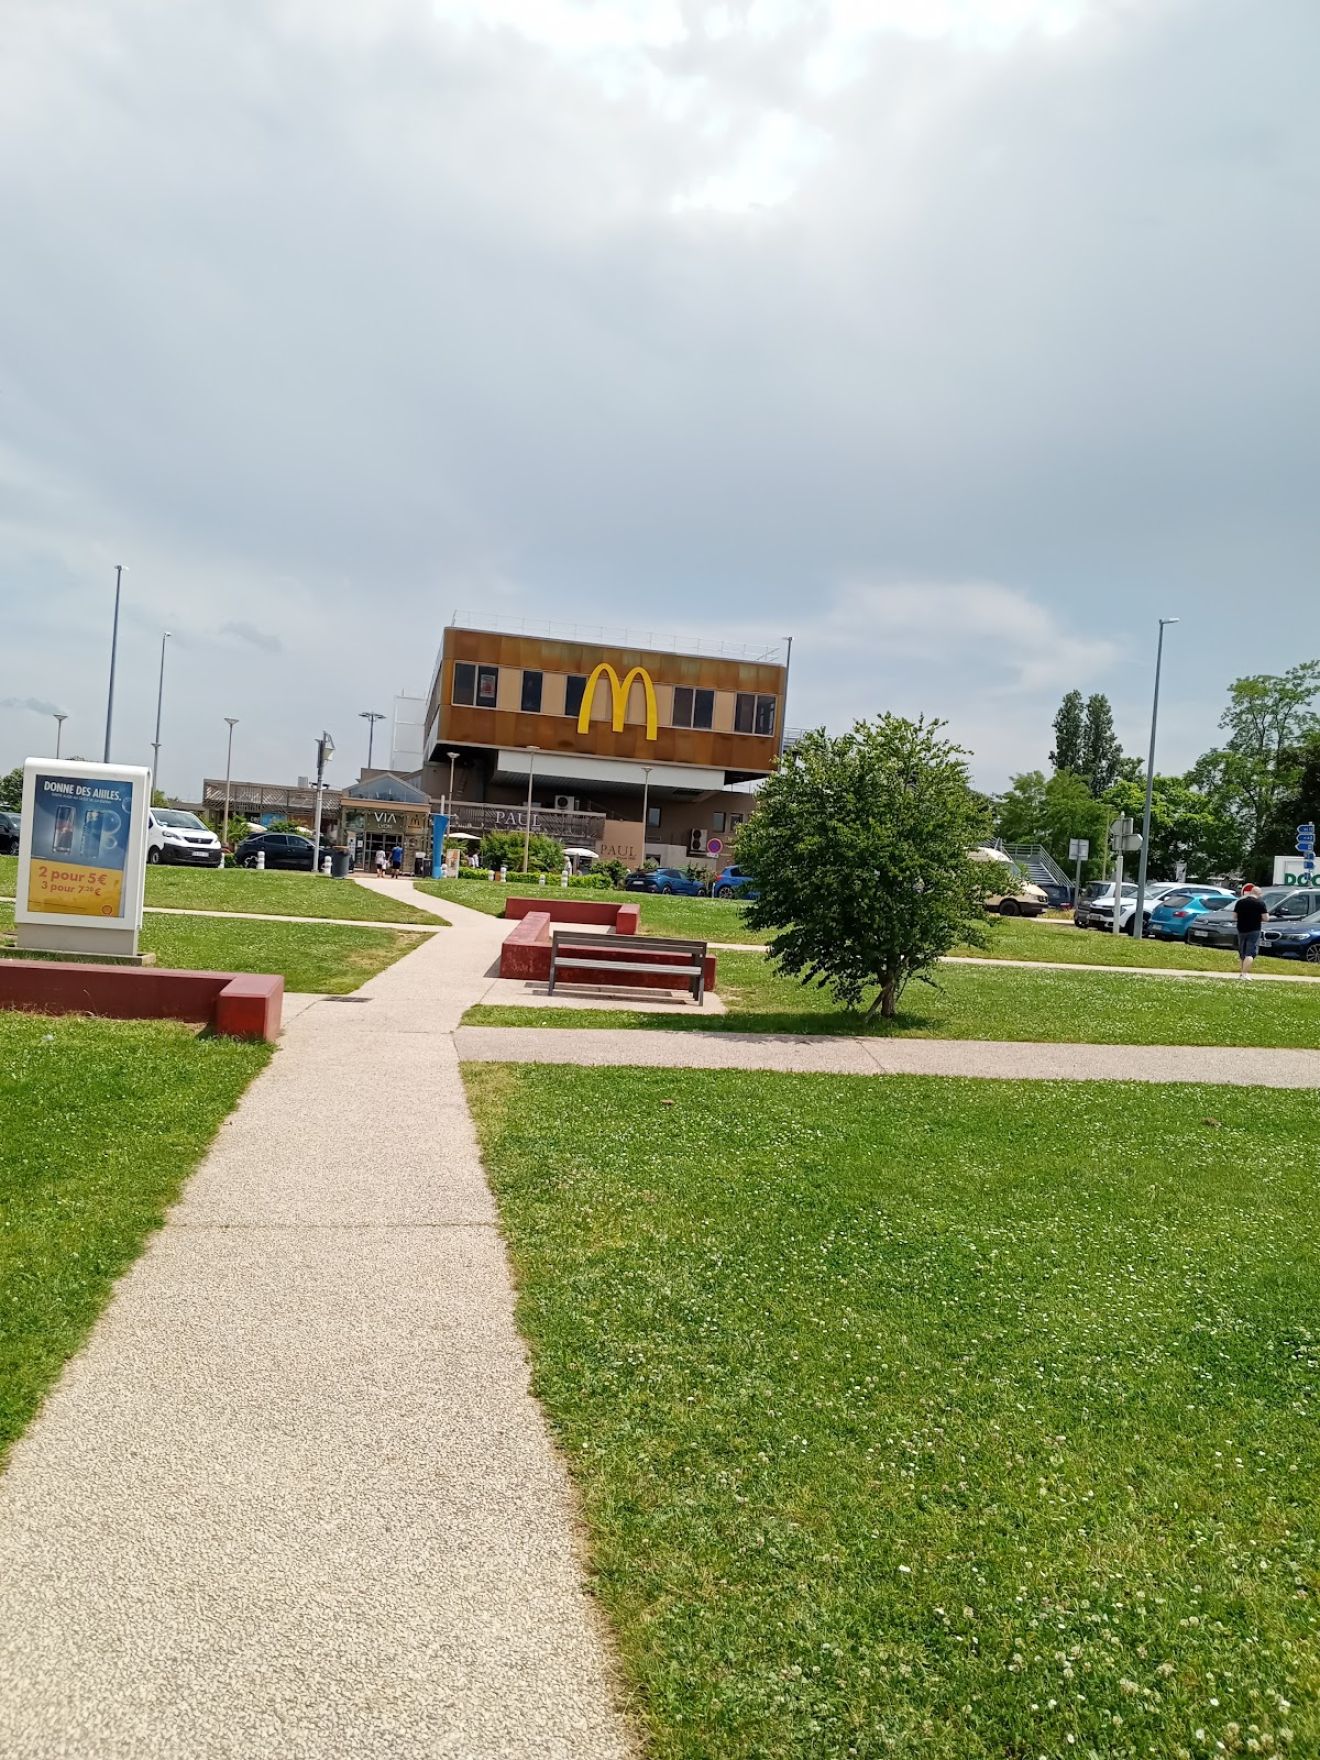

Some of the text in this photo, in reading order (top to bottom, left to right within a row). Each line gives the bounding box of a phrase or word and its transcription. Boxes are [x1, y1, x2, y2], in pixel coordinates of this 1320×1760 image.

[577, 663, 658, 741] M
[44, 781, 75, 795] DONNE
[76, 786, 92, 797] DES
[374, 812, 397, 824] VIA
[496, 811, 542, 827] PAUL
[600, 844, 637, 857] PAUL
[38, 866, 48, 878] 2
[50, 870, 85, 882] pour
[41, 880, 48, 889] 3
[50, 883, 75, 893] pour
